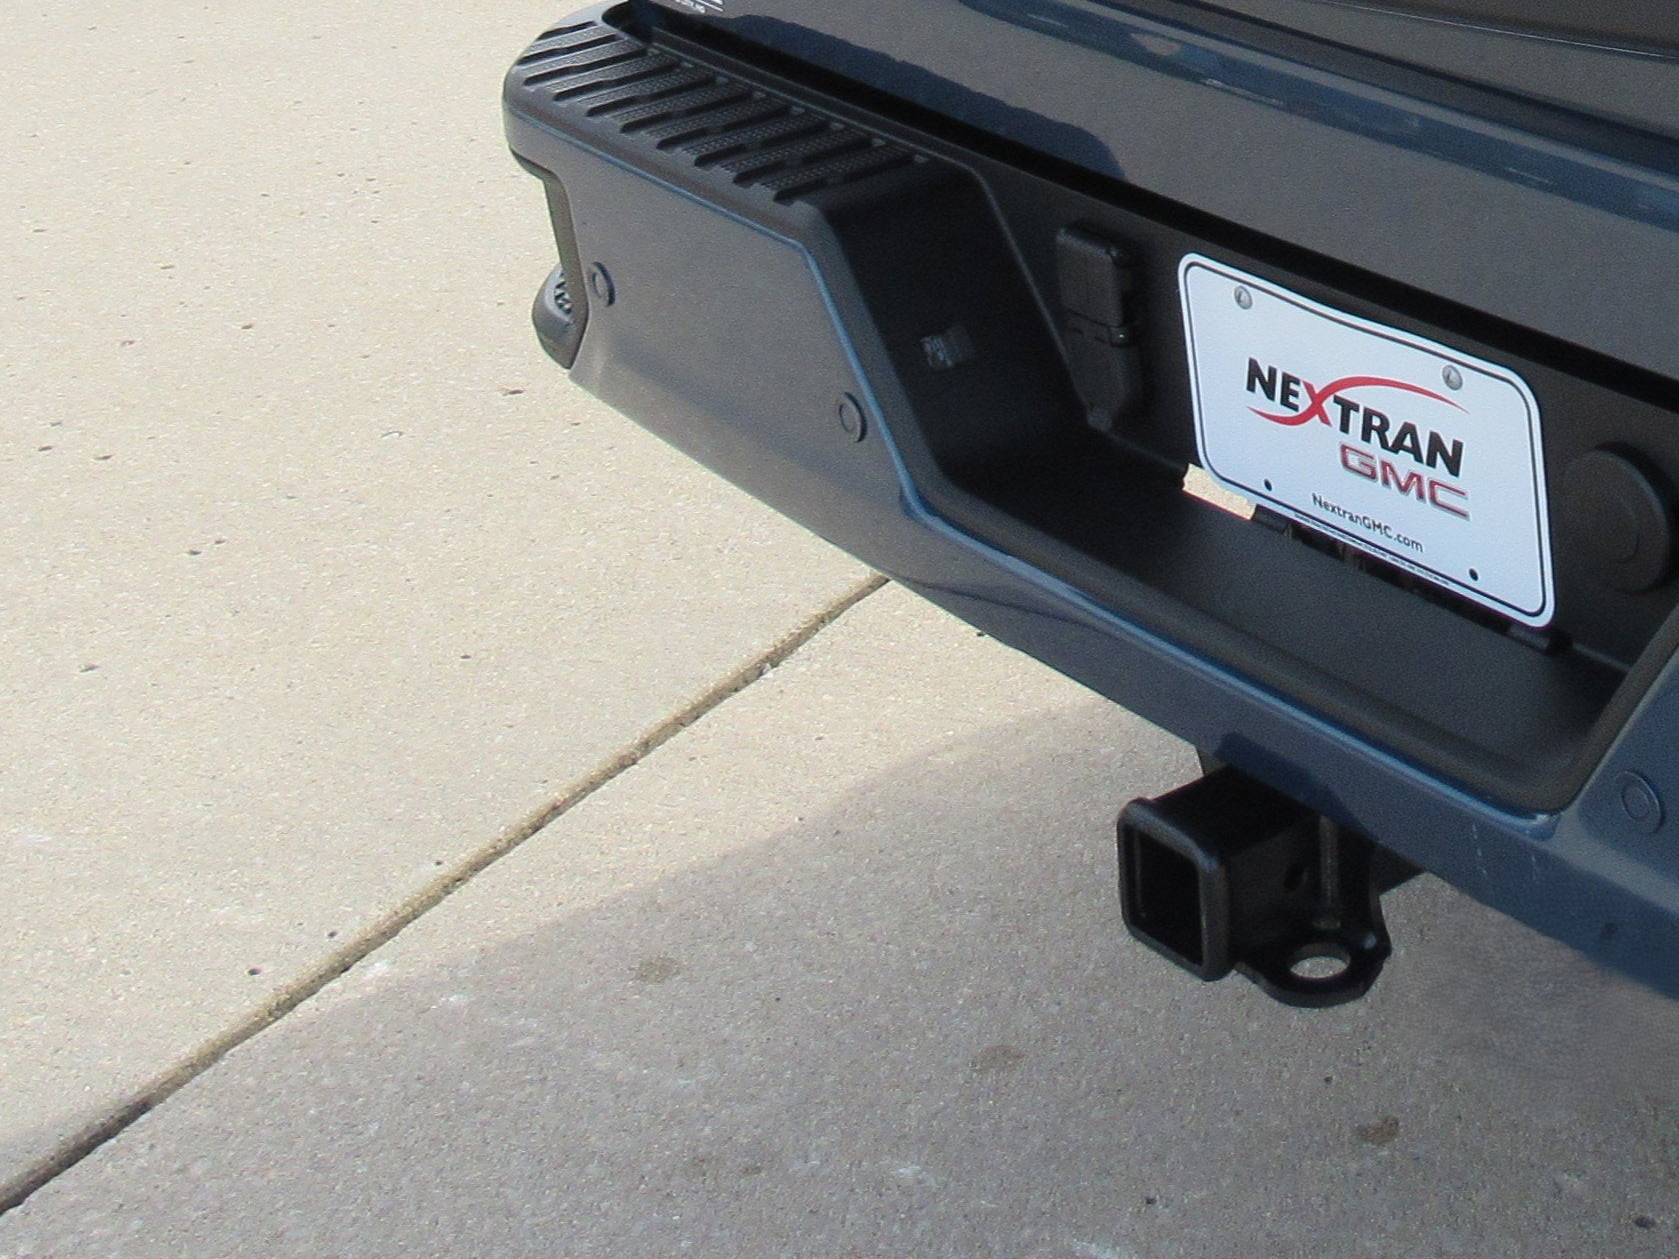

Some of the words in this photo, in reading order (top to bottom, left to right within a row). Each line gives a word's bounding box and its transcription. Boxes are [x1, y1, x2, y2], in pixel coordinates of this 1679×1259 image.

[1246, 356, 1464, 478] NEXTRAN
[1339, 441, 1470, 522] GMC
[1312, 492, 1424, 554] NextranGMC.com
